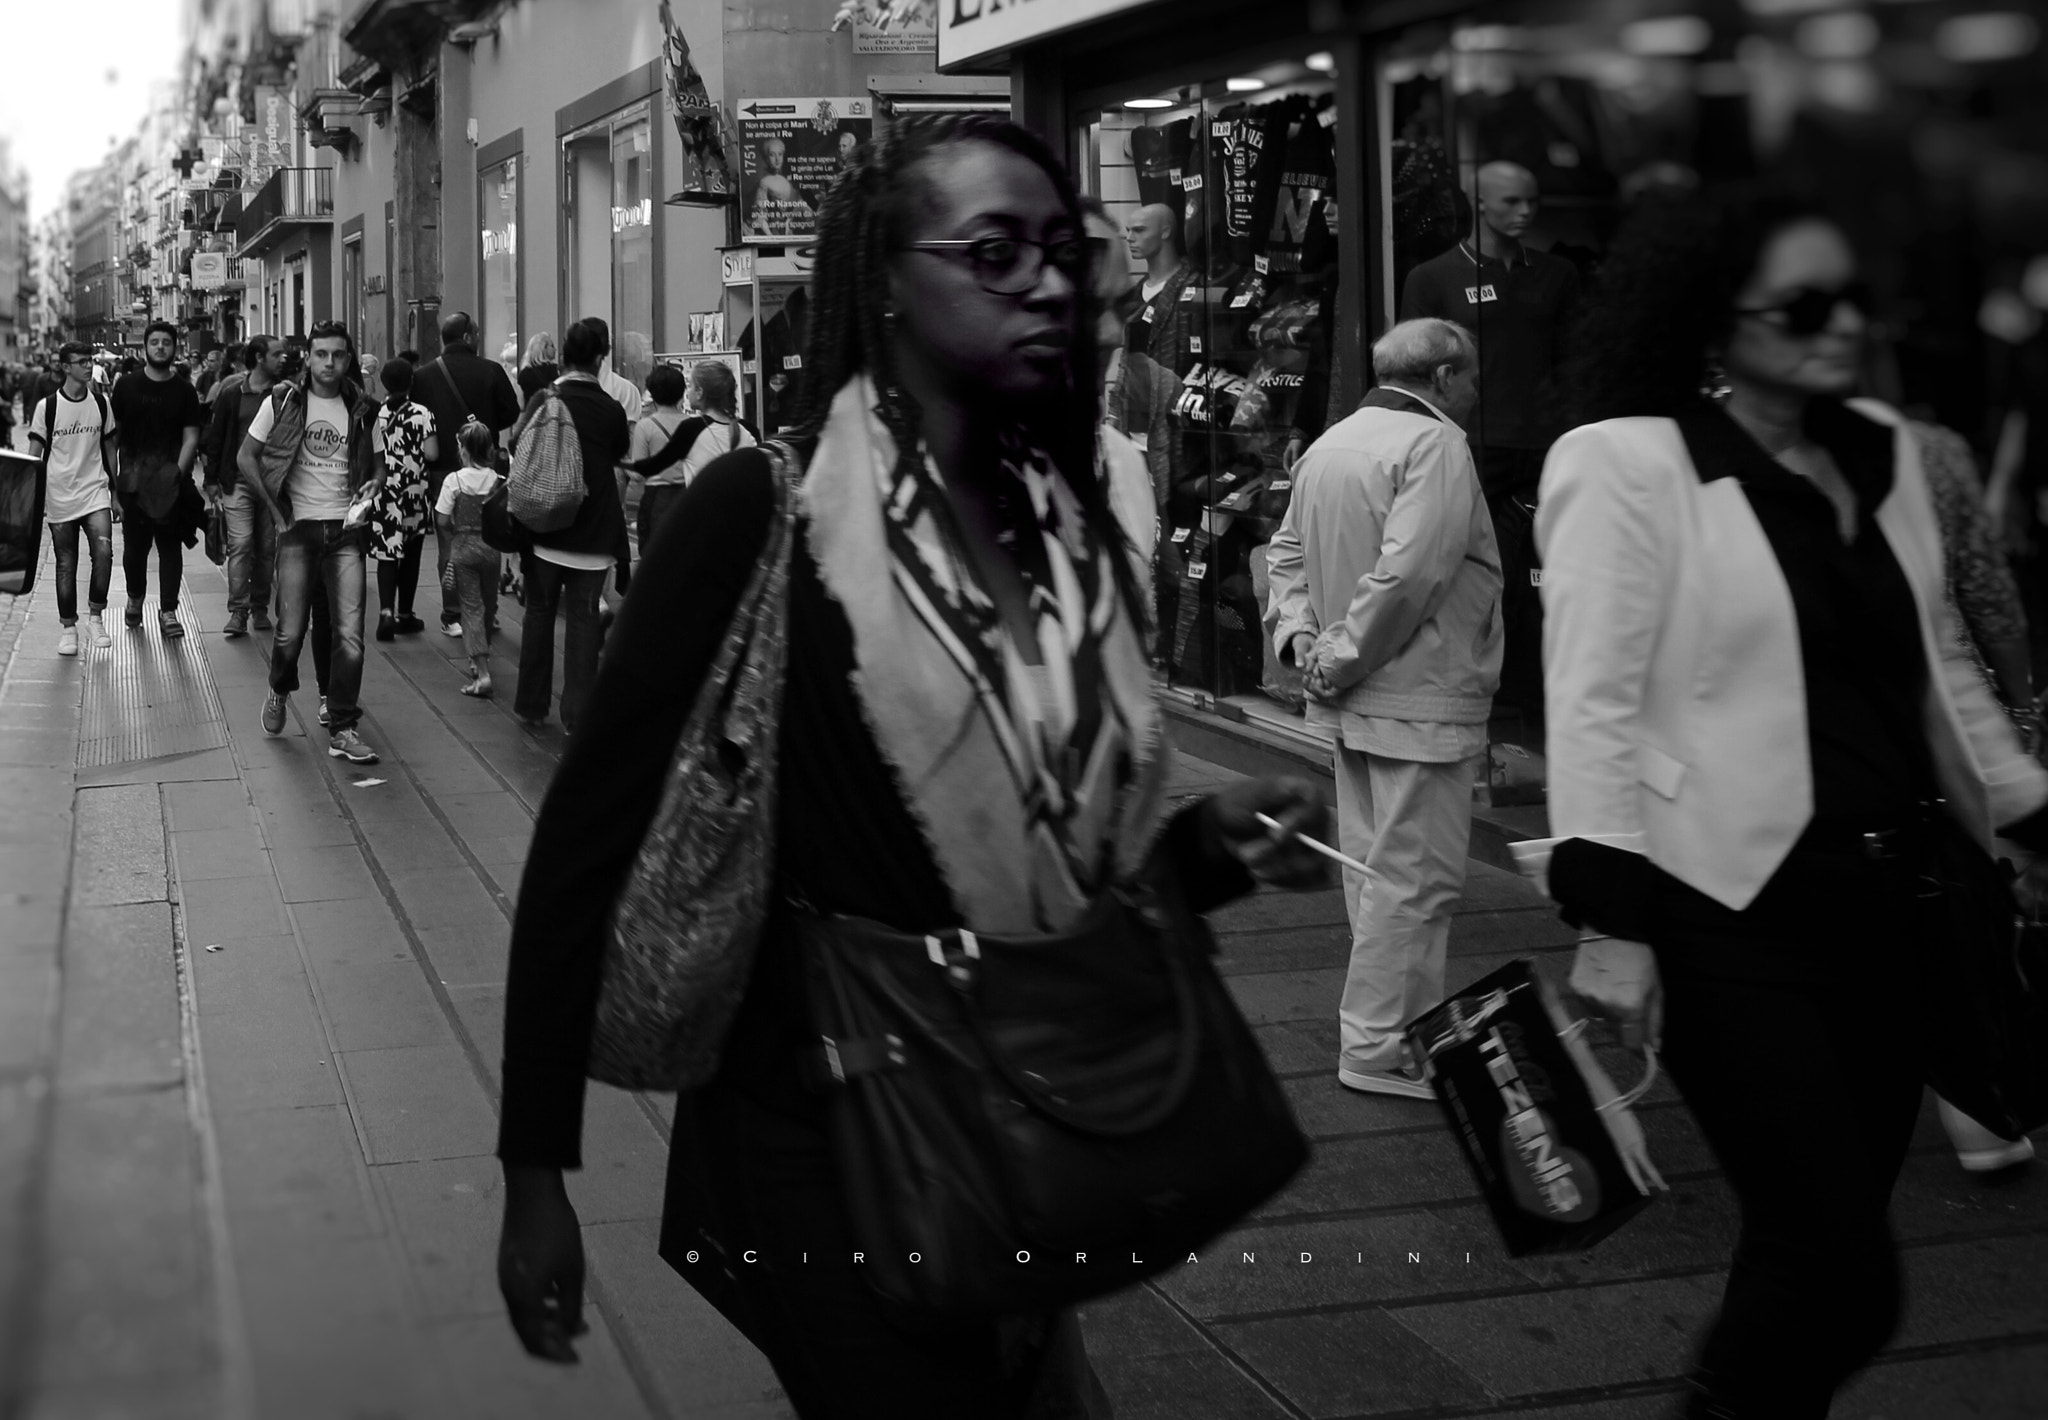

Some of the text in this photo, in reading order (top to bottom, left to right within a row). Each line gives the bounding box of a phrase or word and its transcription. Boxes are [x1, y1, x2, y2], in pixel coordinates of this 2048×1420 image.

[765, 122, 782, 130] colpa
[782, 130, 793, 138] Re
[744, 144, 757, 176] 1751
[763, 200, 808, 208] Re Nasone
